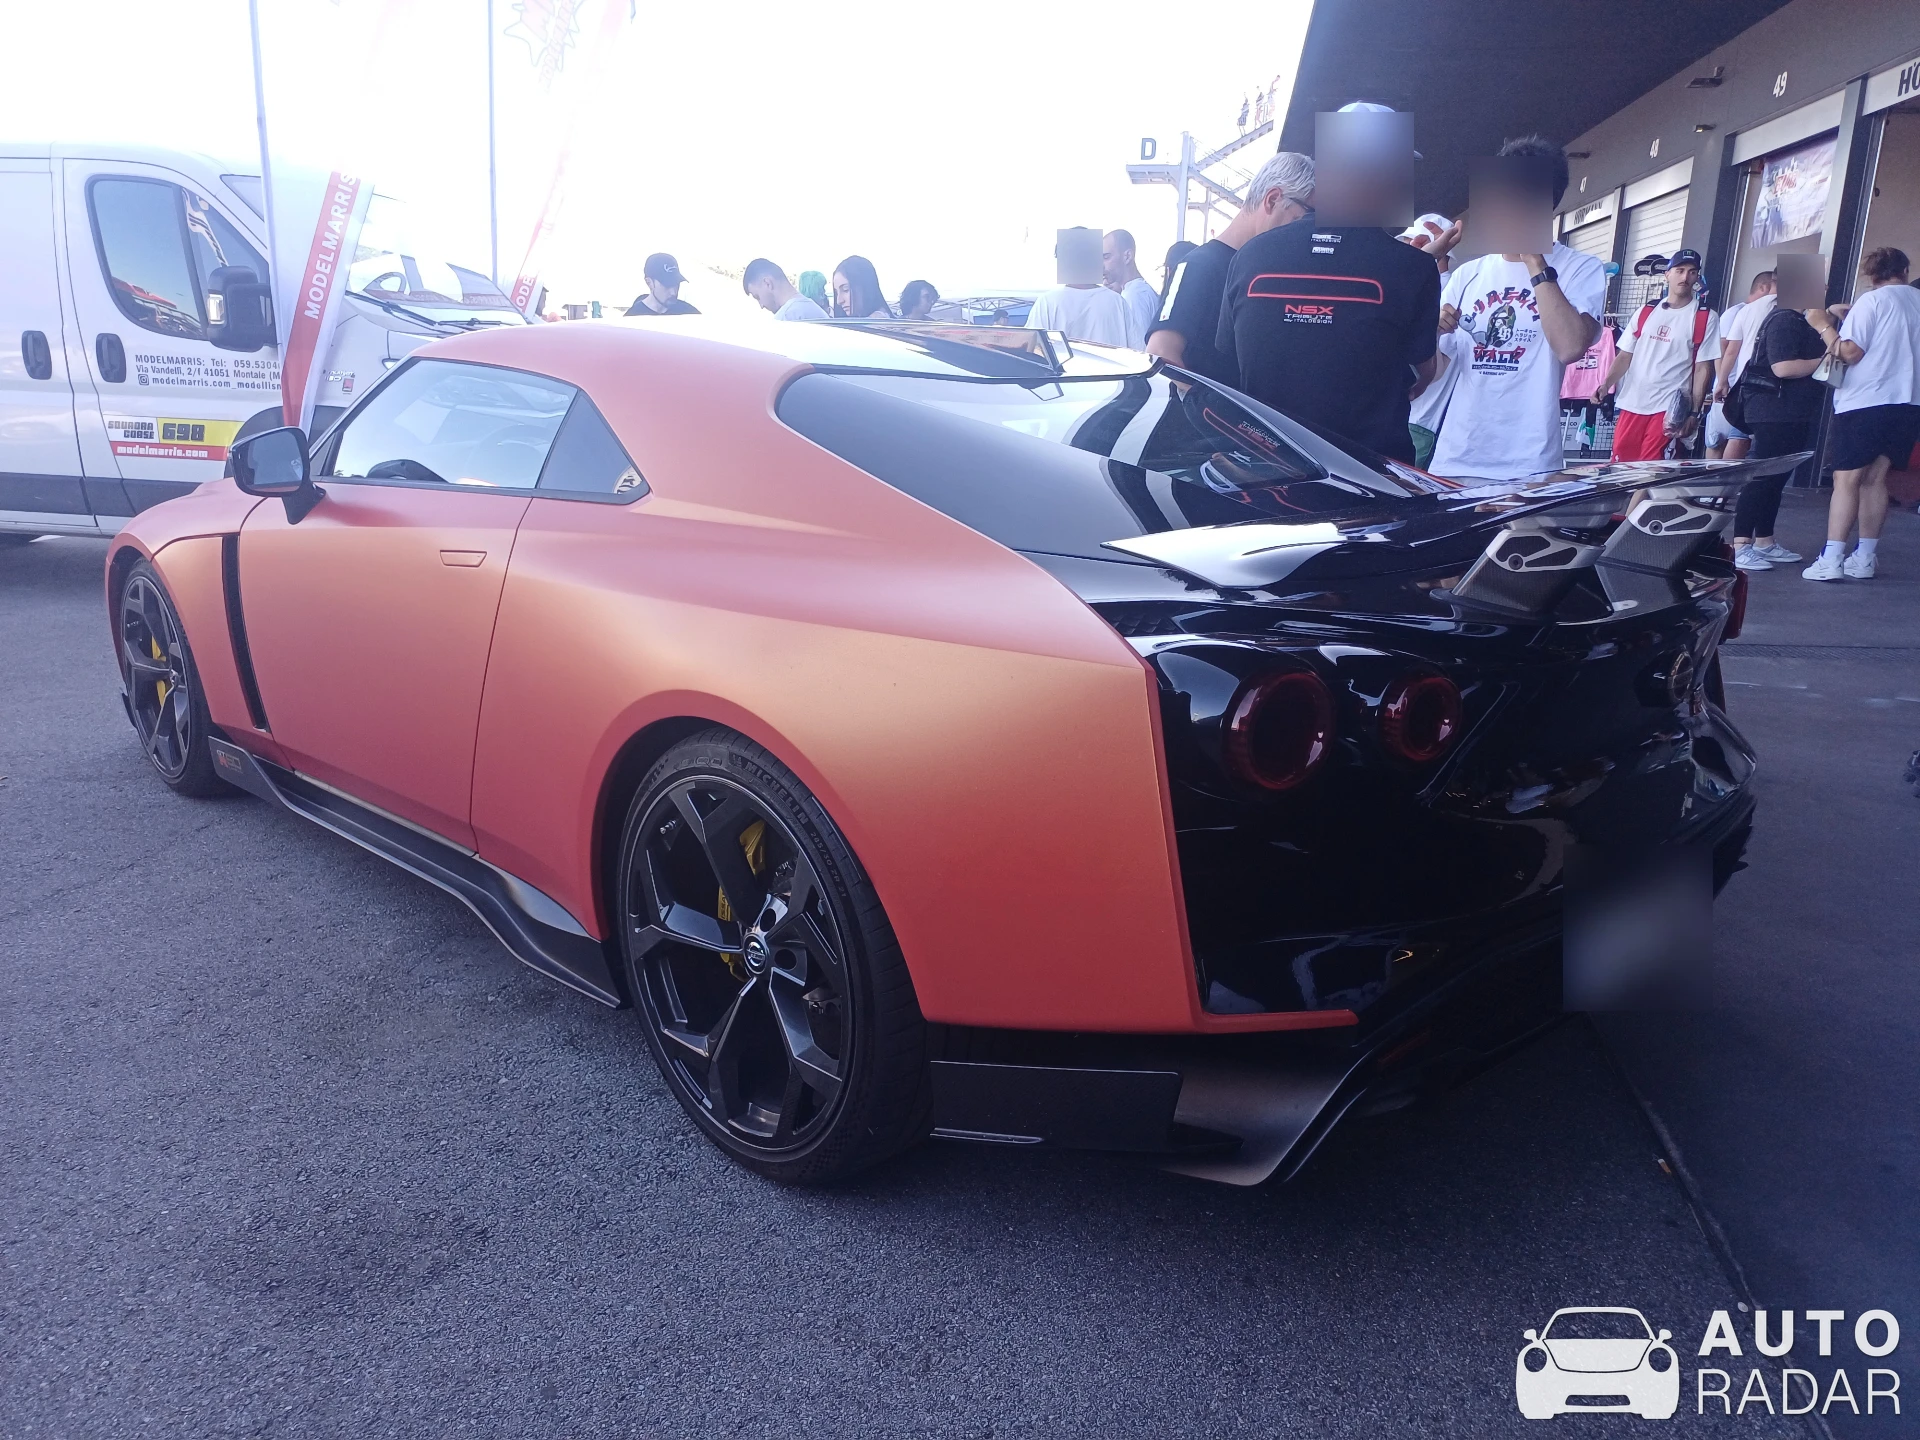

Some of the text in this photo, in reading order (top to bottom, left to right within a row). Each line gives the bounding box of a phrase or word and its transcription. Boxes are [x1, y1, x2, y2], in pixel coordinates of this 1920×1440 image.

[1772, 71, 1788, 98] 49
[1140, 137, 1157, 160] D
[303, 172, 359, 320] MODELMARRIS
[1284, 304, 1334, 315] NSX
[135, 354, 280, 370] MODELMARRIS: Tel: 059.5304
[136, 364, 149, 373] Via
[203, 367, 230, 378] 41051
[233, 369, 266, 380] Montale
[162, 422, 206, 442] 698
[116, 445, 208, 458] modelmarris.com
[744, 761, 810, 825] MICHELIN
